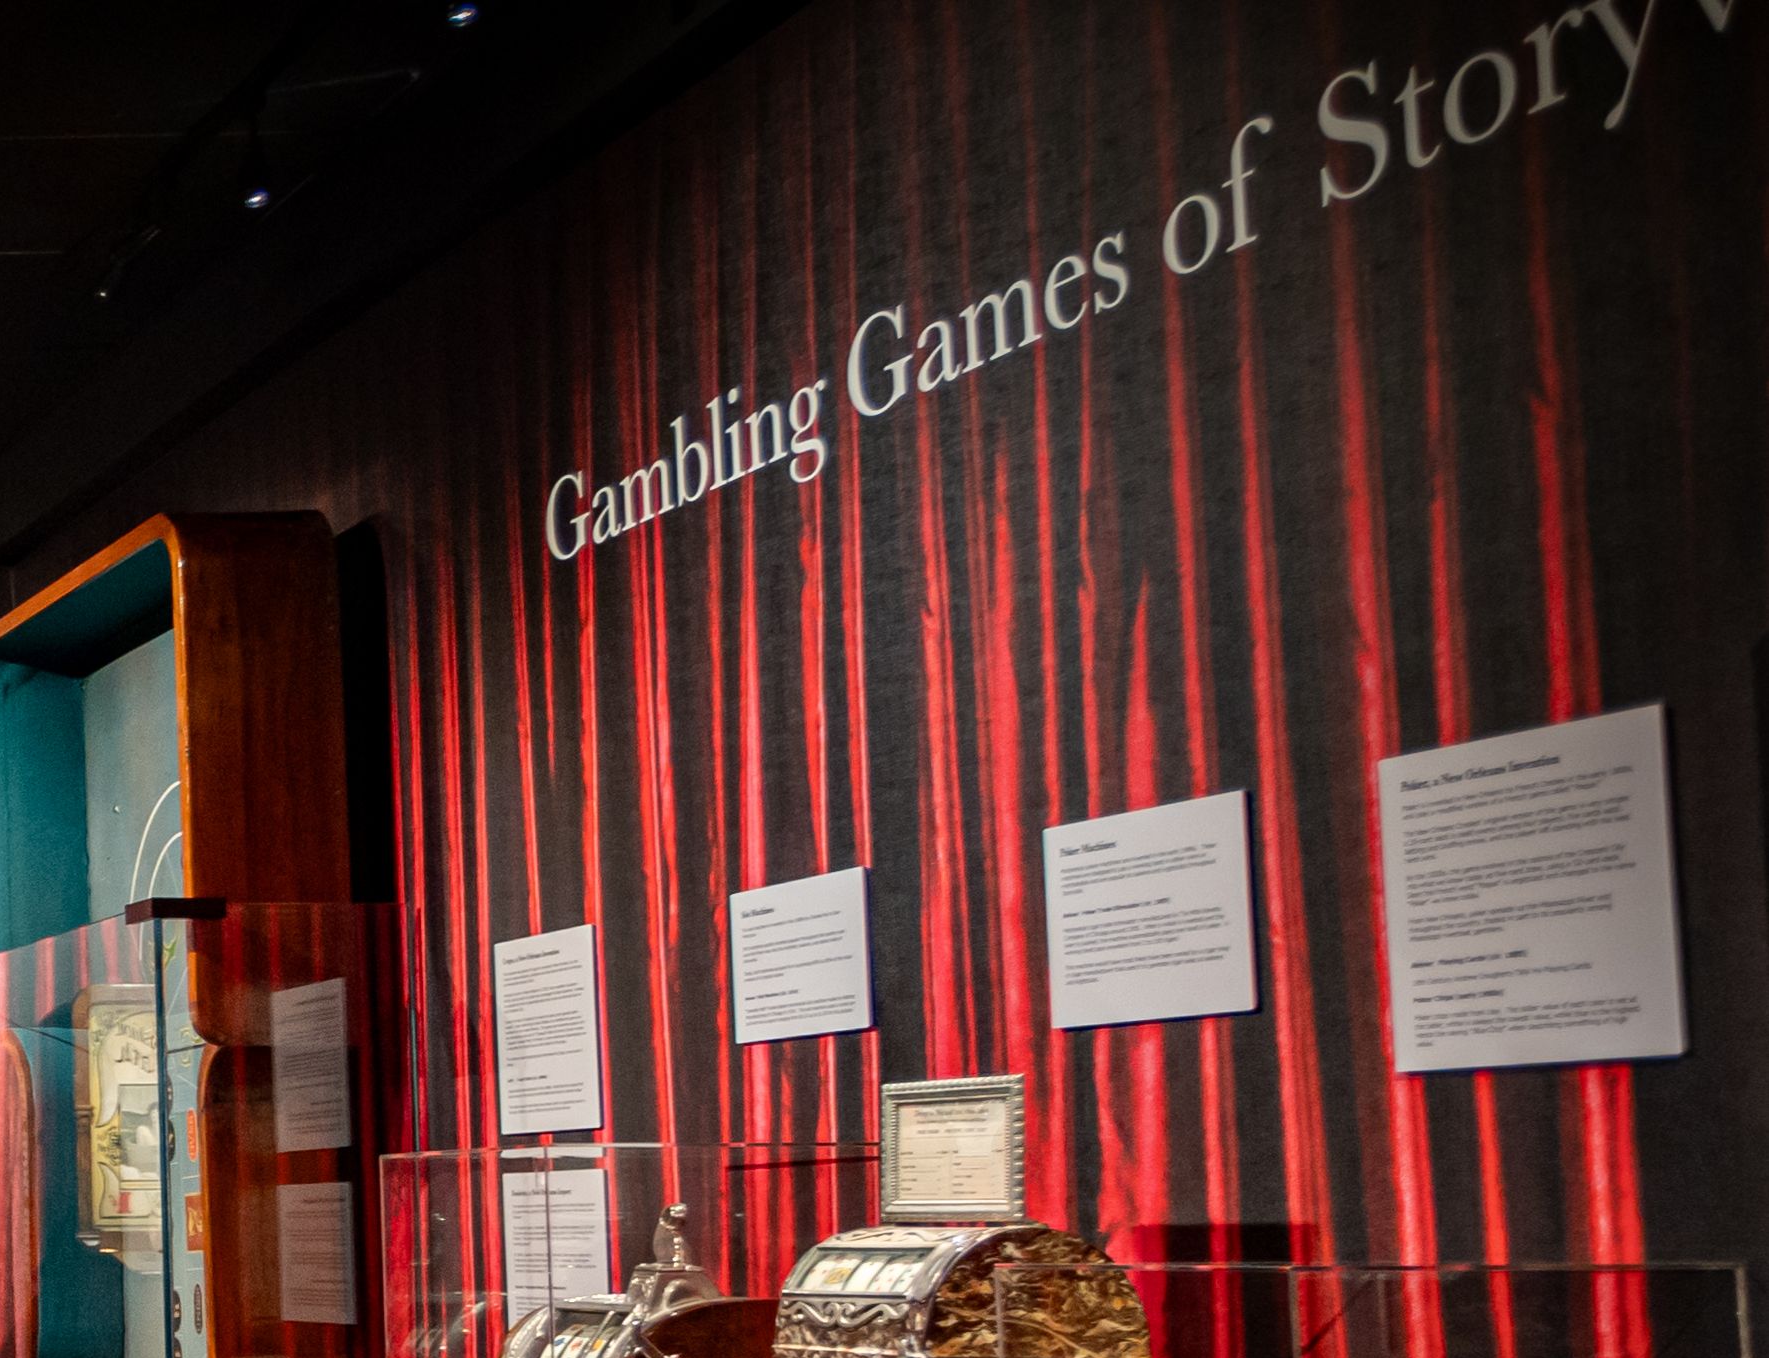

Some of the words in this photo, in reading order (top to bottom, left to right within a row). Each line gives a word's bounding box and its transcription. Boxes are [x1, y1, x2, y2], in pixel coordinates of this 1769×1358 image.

[546, 379, 827, 560] Gambling
[847, 232, 1128, 416] Games
[1163, 118, 1272, 274] of
[1317, 0, 1734, 207] Story
